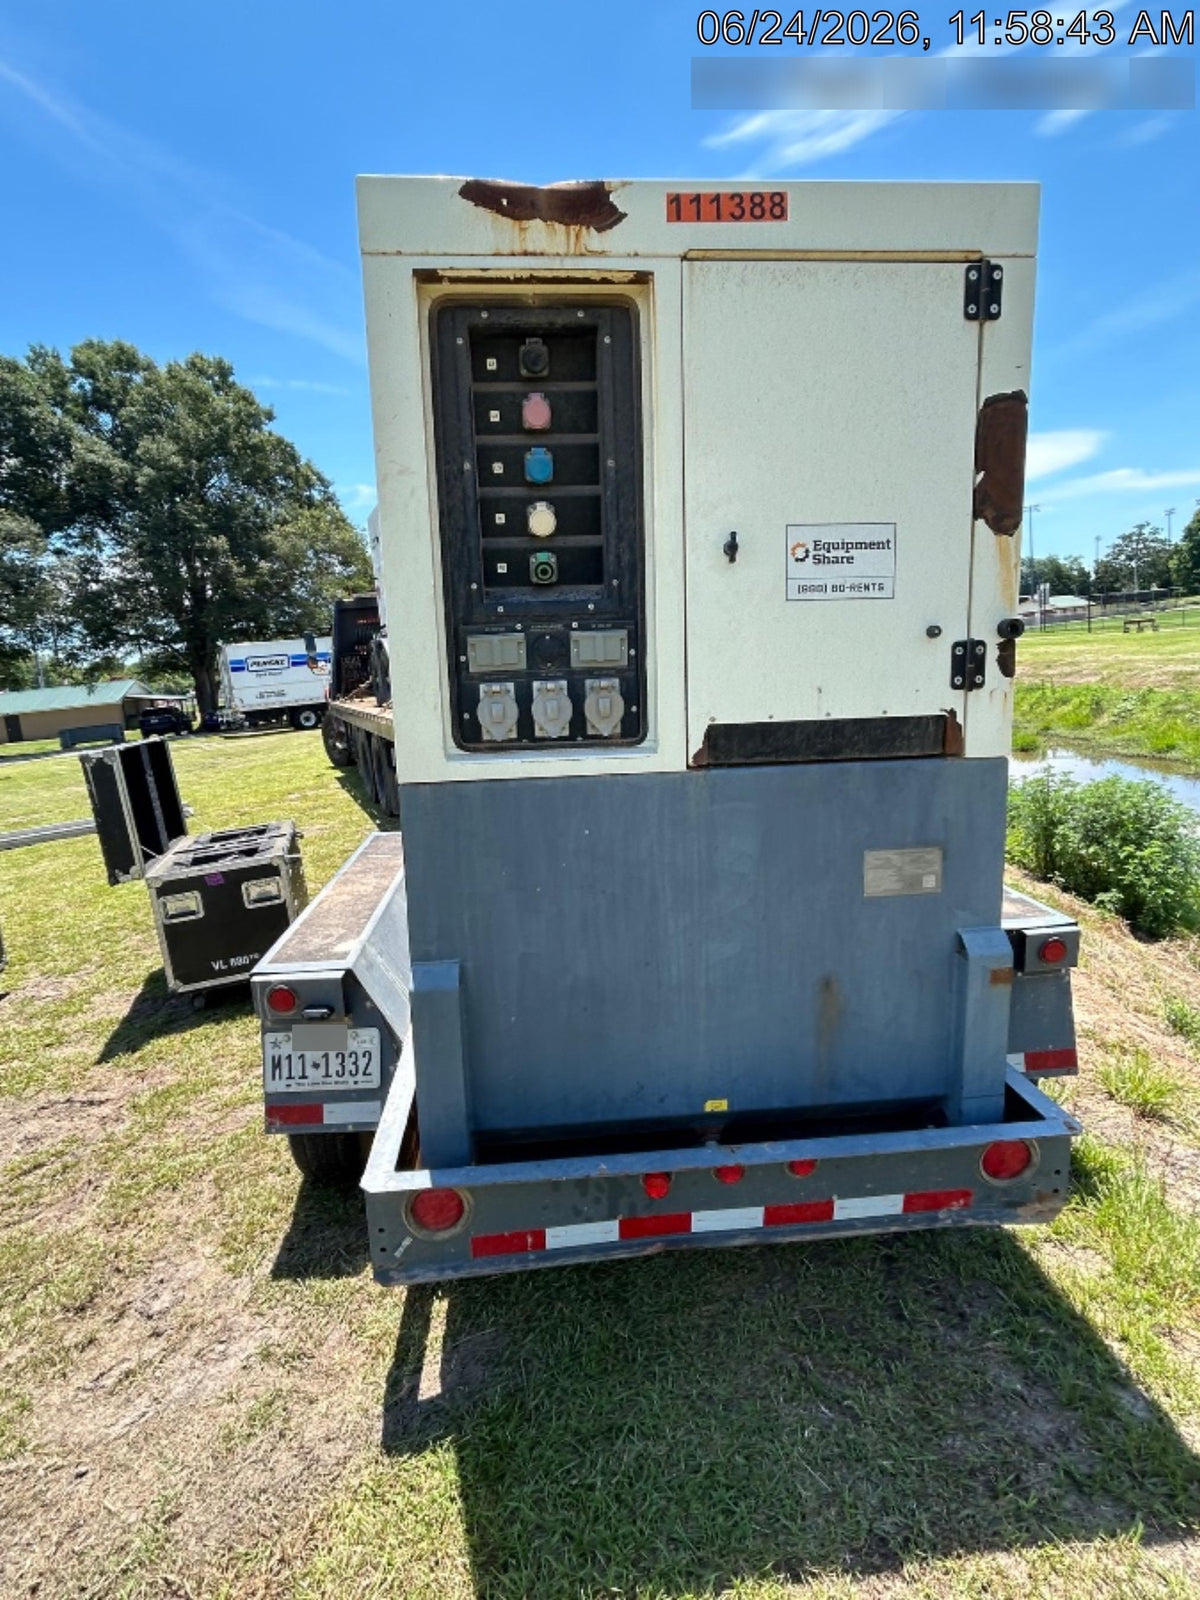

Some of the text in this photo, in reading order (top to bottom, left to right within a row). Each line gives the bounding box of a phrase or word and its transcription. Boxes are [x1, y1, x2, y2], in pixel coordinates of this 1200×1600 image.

[669, 192, 786, 221] 111388
[813, 538, 892, 553] Equipment
[812, 554, 855, 565] Share
